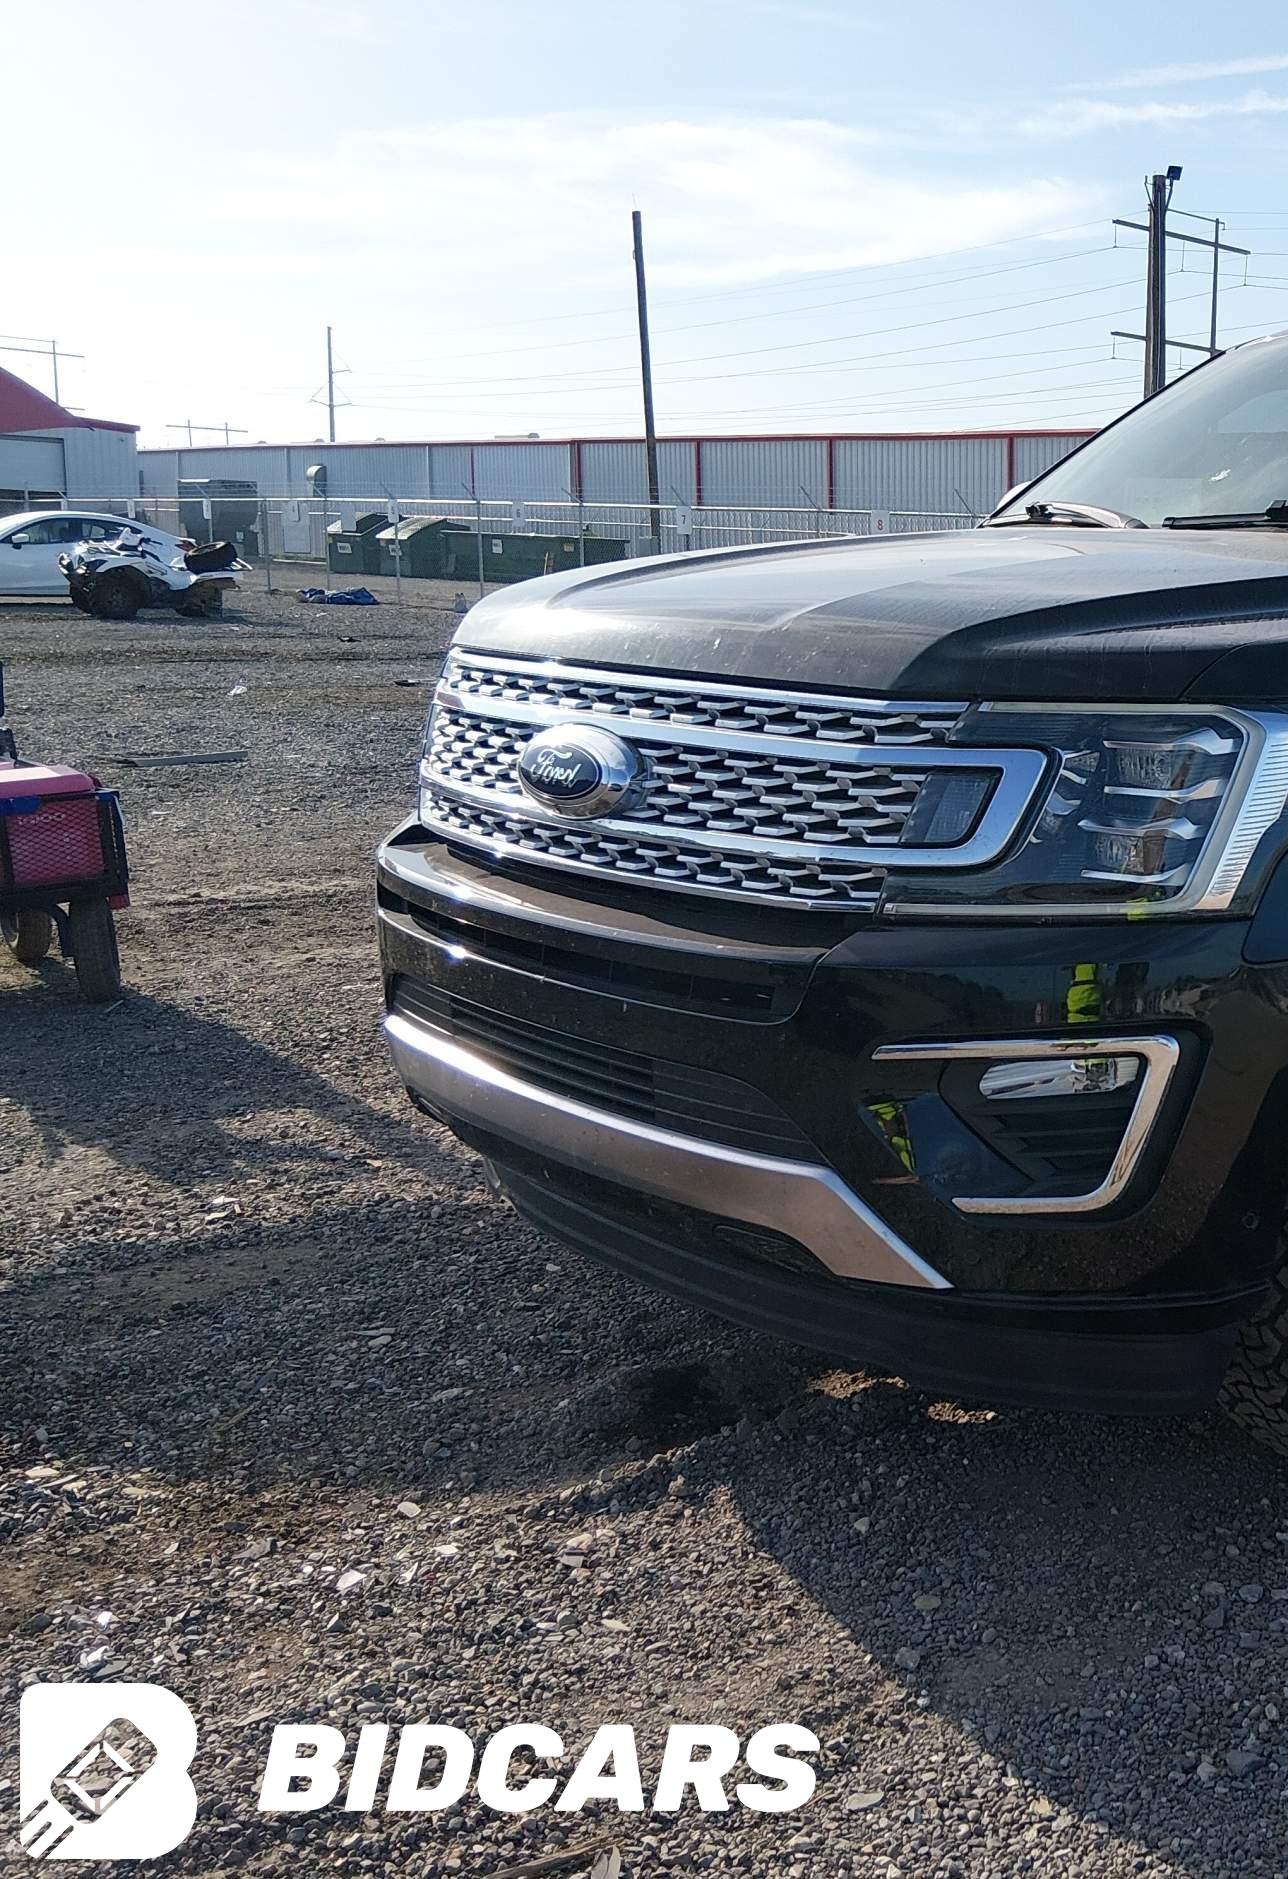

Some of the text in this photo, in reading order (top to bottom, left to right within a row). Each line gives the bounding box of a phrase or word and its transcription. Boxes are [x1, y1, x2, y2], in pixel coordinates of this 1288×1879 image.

[681, 514, 687, 525] 7
[877, 519, 883, 531] 8
[530, 748, 582, 784] Ford
